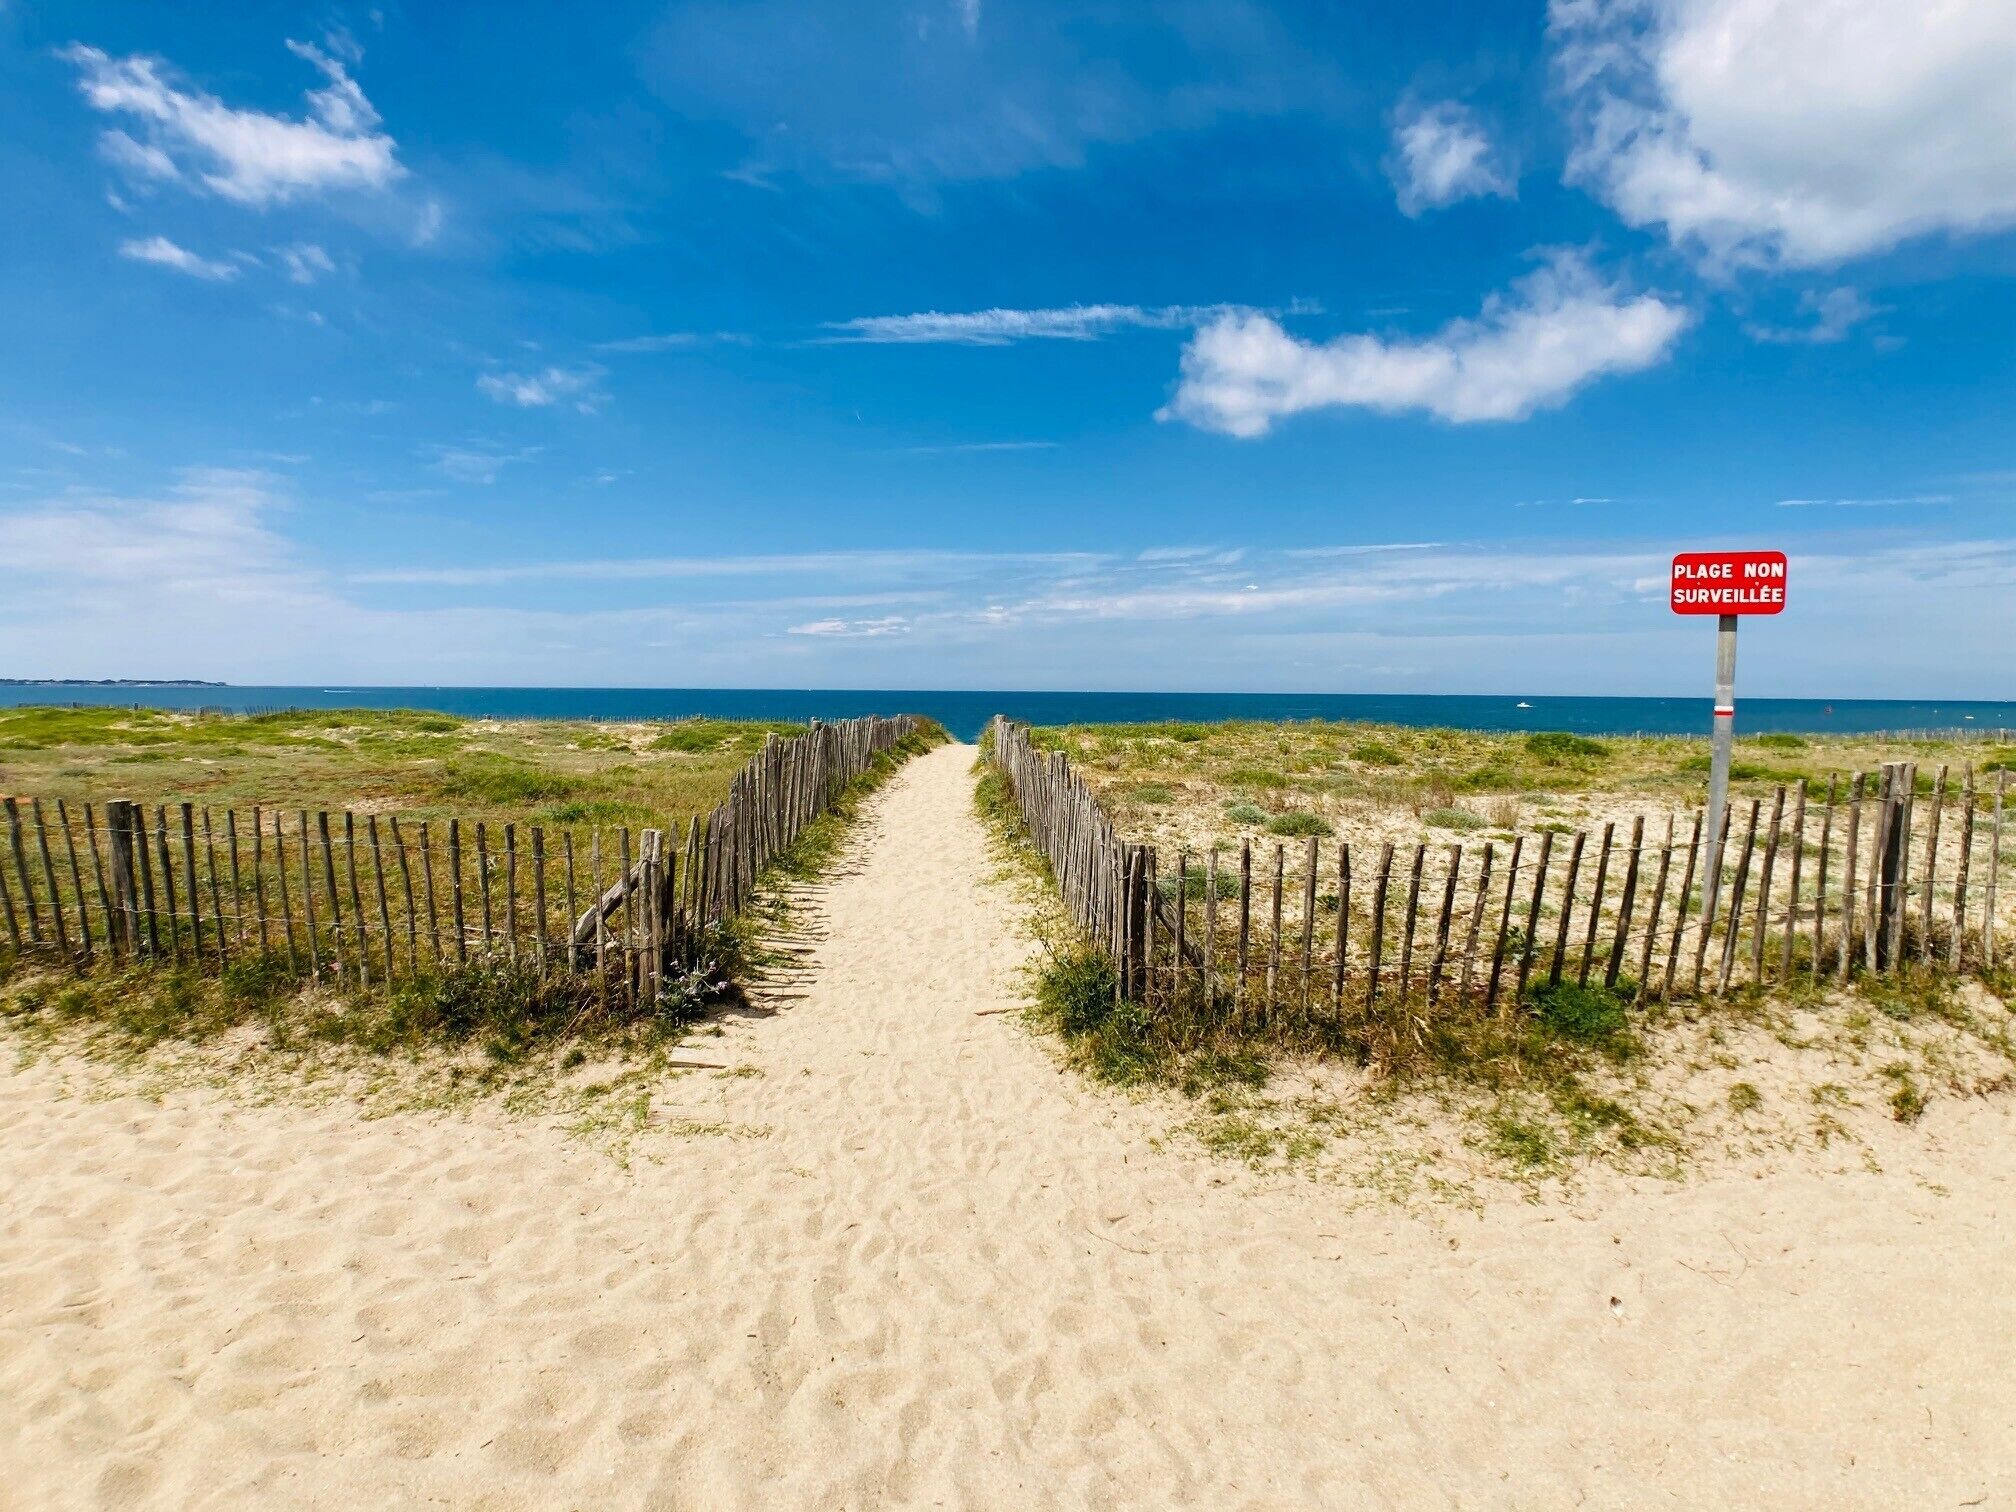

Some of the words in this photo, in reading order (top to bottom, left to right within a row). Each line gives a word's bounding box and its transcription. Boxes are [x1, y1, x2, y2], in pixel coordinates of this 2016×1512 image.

[1674, 563, 1733, 579] PLAGE
[1744, 562, 1784, 578] NON
[1673, 585, 1784, 603] SURVEILLÉE
